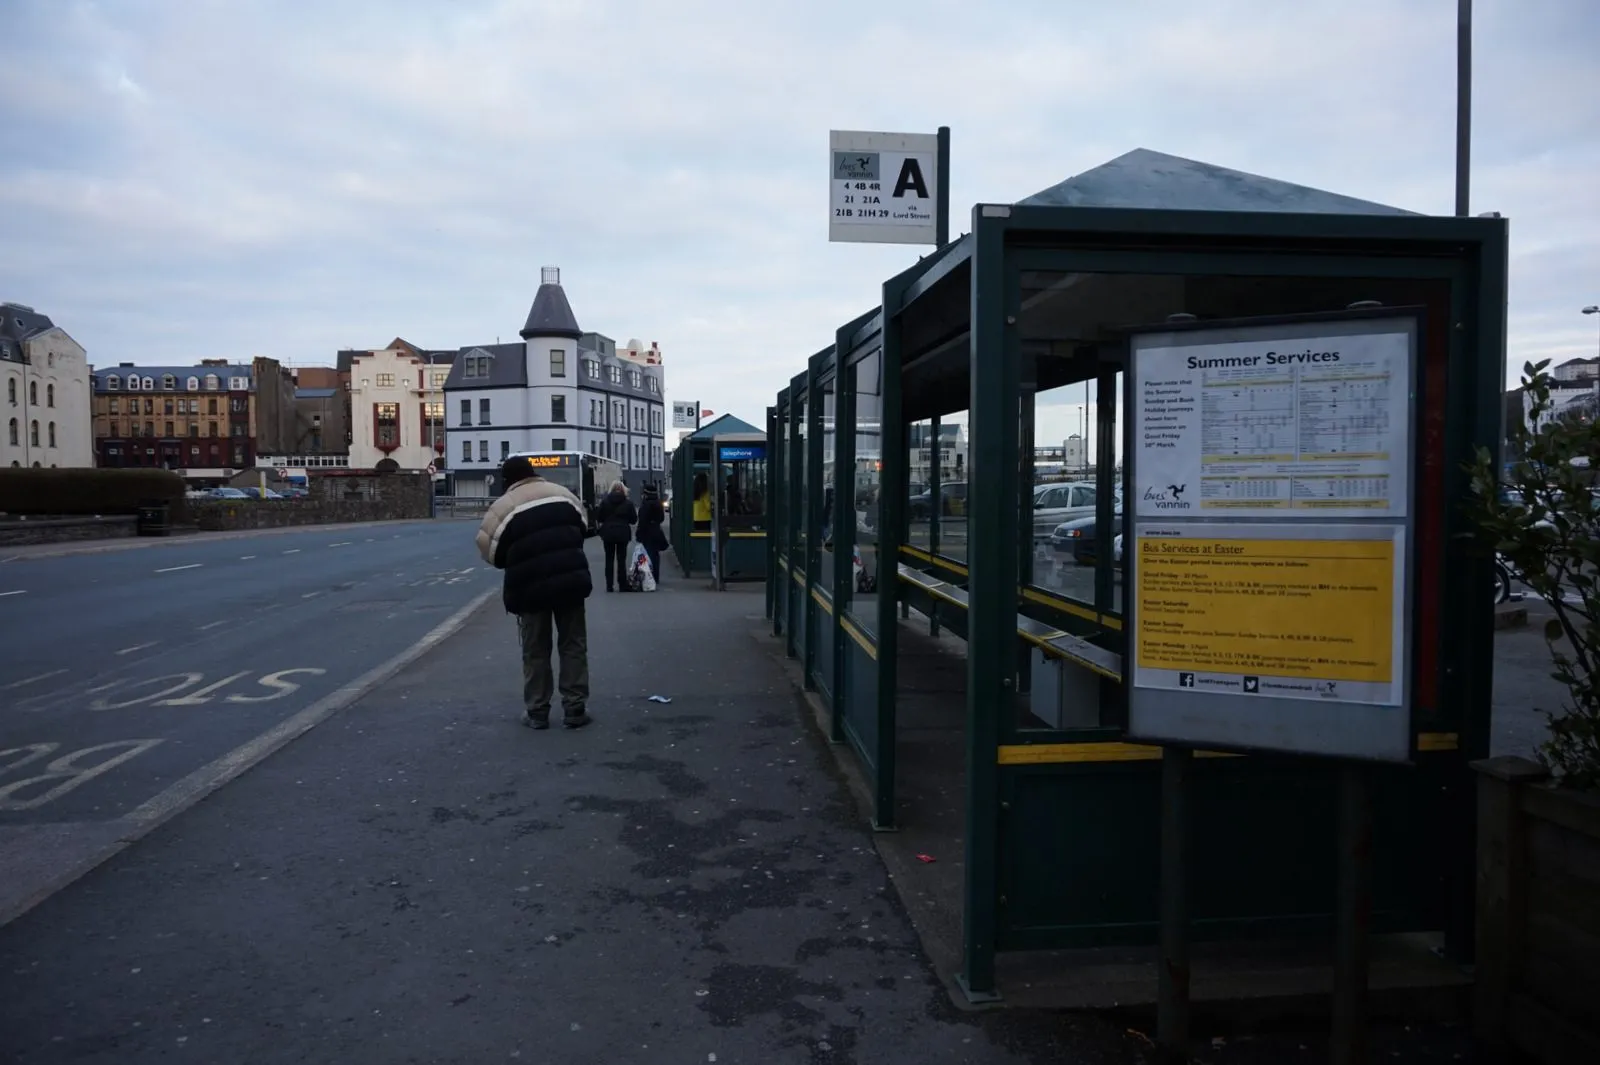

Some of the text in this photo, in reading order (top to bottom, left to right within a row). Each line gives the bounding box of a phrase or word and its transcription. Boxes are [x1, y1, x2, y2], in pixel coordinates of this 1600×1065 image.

[892, 157, 930, 198] A
[844, 182, 850, 190] 4
[869, 183, 881, 191] 4R
[863, 196, 881, 204] 21A
[835, 208, 889, 218] 21B 21H 29
[1187, 349, 1340, 369] Summer Services
[687, 407, 694, 417] B
[1155, 500, 1190, 509] vannin
[1143, 543, 1245, 555] Bus Services at Easter
